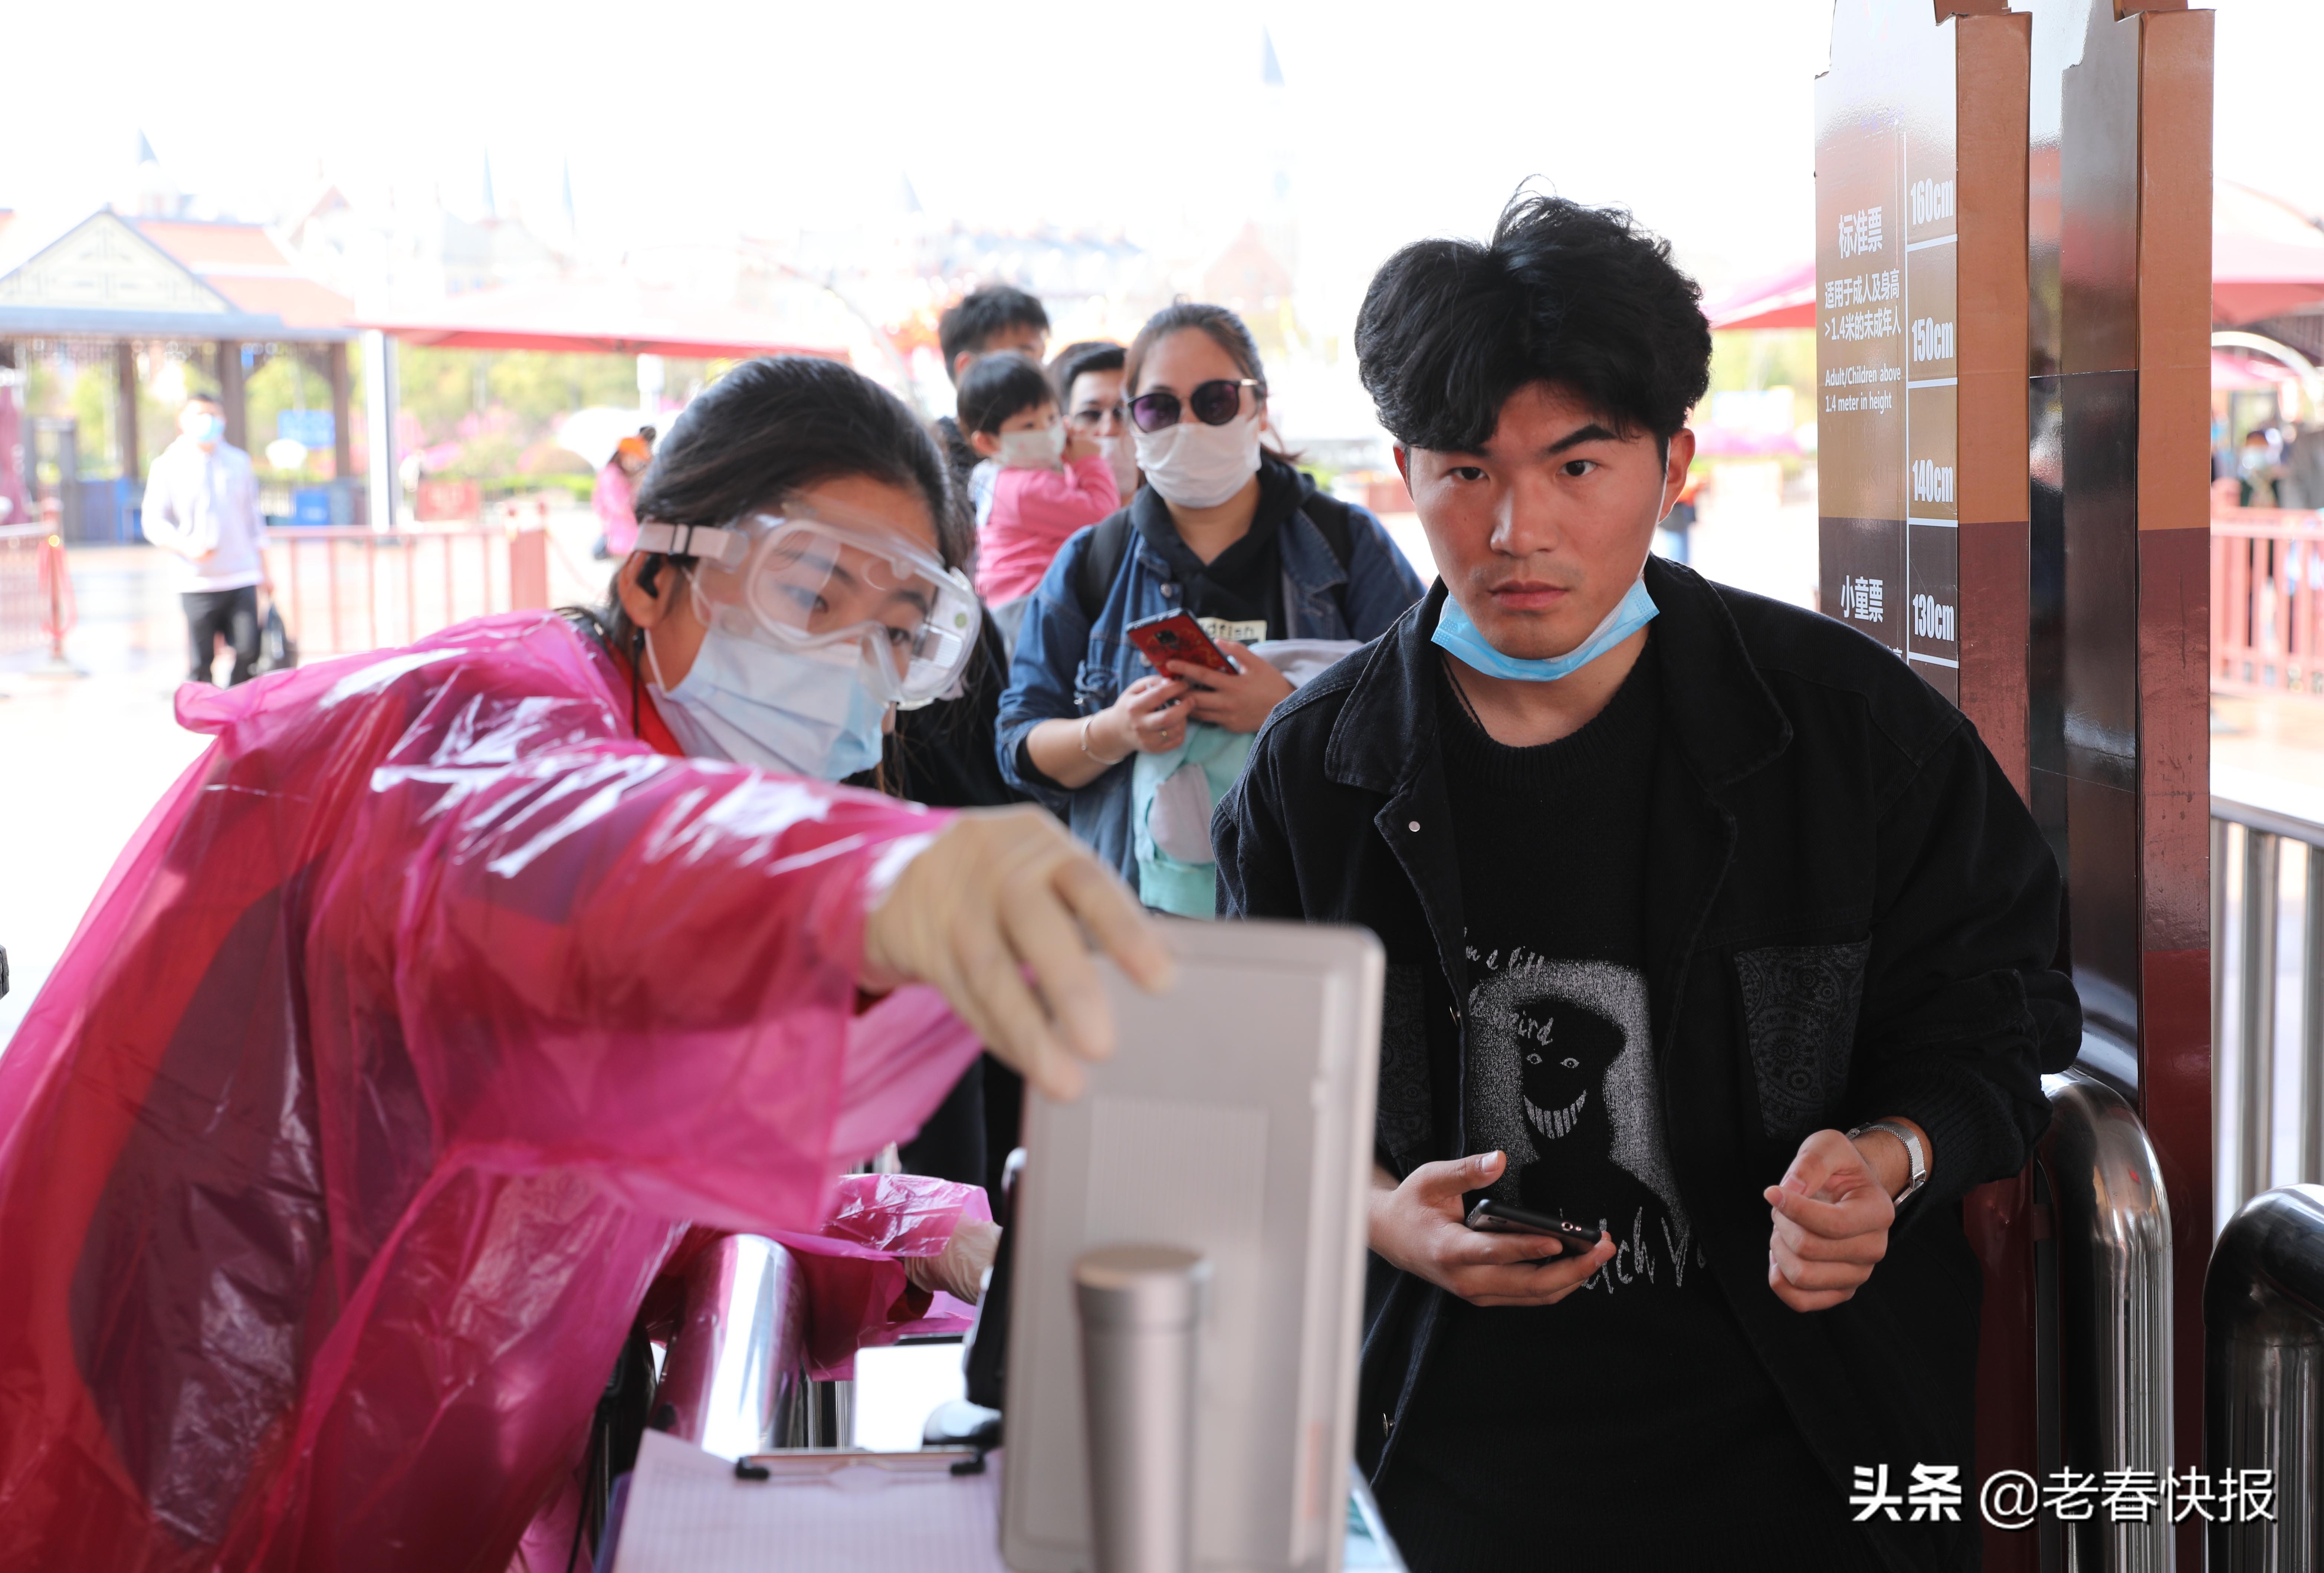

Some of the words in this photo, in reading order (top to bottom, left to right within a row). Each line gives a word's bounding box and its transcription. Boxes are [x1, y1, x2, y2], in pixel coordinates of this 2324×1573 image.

[1911, 178, 1954, 225] 160cm
[1838, 206, 1883, 259] 标准票
[1825, 268, 1899, 309] 适用于成人及身高
[1825, 305, 1901, 341] >1.4米的未成年人
[1911, 317, 1954, 362] 150cm
[1825, 365, 1877, 388] Adult/Children
[1880, 363, 1901, 382] above
[1825, 395, 1836, 412] 1.4
[1838, 395, 1859, 411] meter
[1861, 391, 1867, 410] in
[1869, 390, 1891, 414] height
[1912, 459, 1953, 503] 140cm
[1840, 575, 1884, 623] 小童票
[1912, 594, 1954, 642] 130cm
